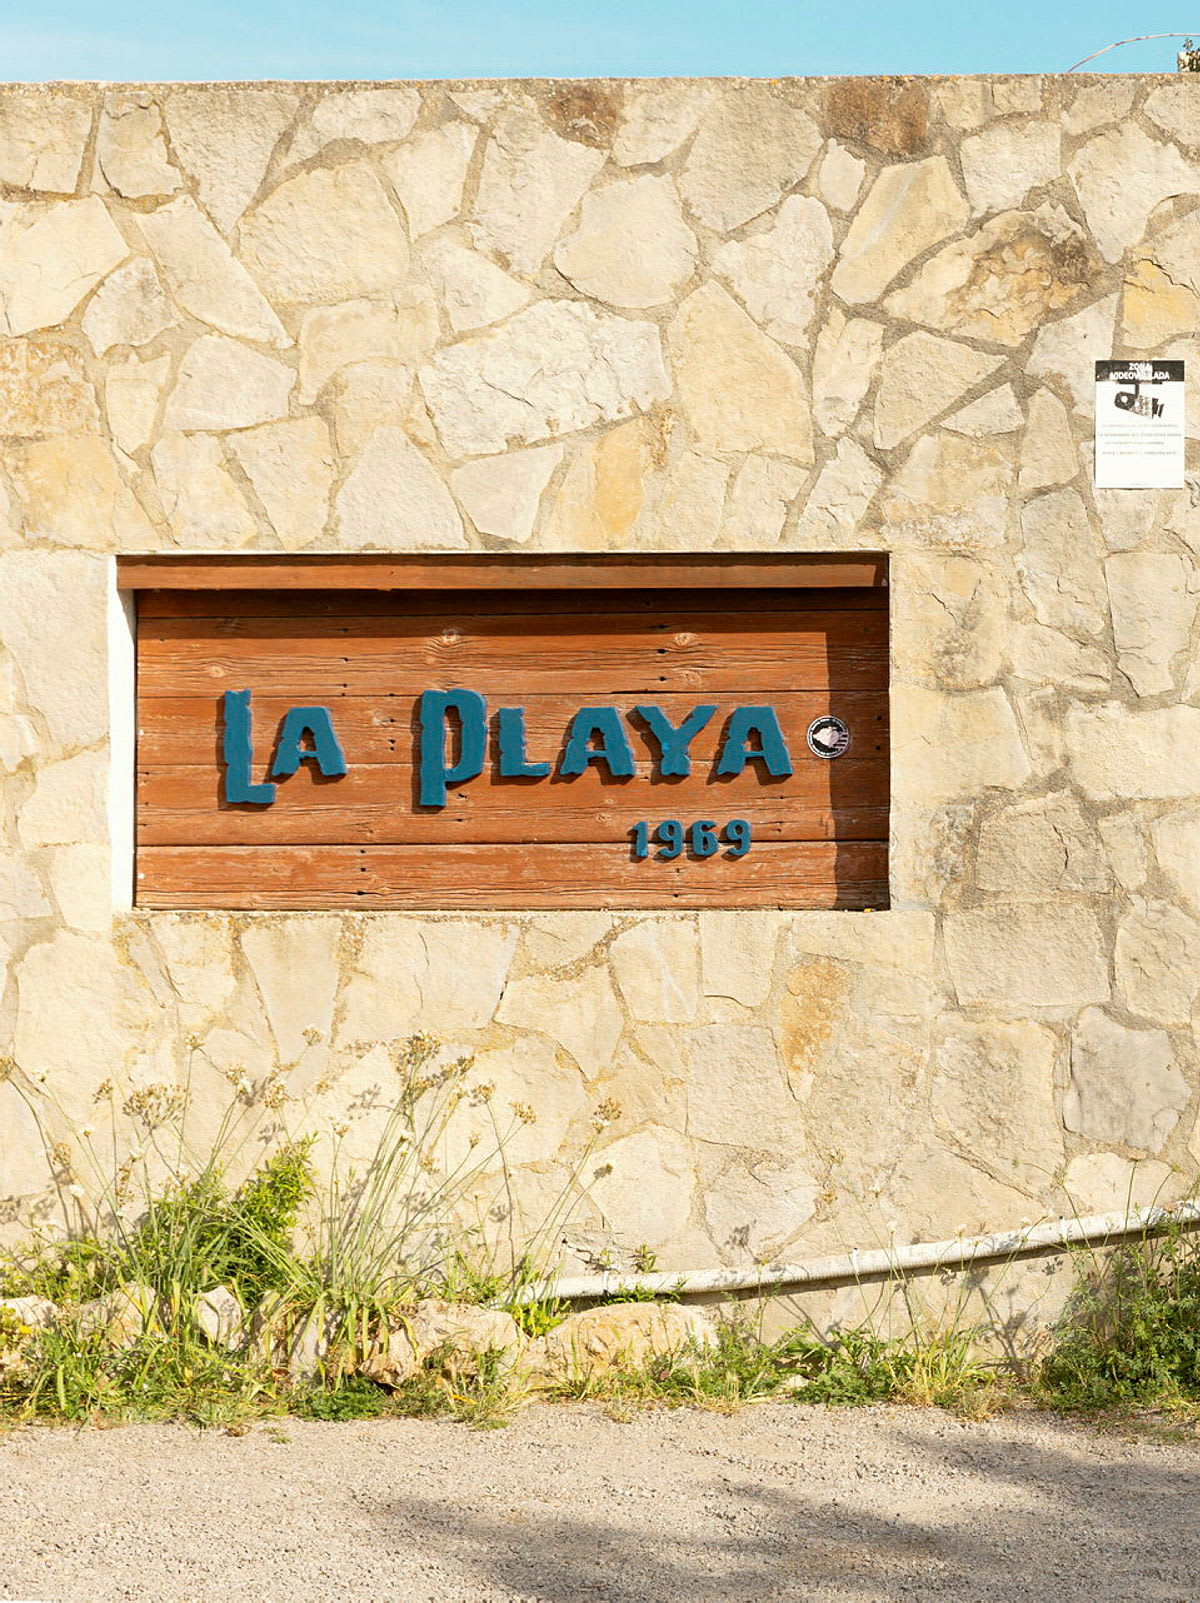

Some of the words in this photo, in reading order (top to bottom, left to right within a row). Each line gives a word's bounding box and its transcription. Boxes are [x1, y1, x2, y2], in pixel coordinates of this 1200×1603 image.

[223, 690, 347, 804] LA
[419, 688, 794, 807] PLAYA
[633, 819, 752, 858] 1969
